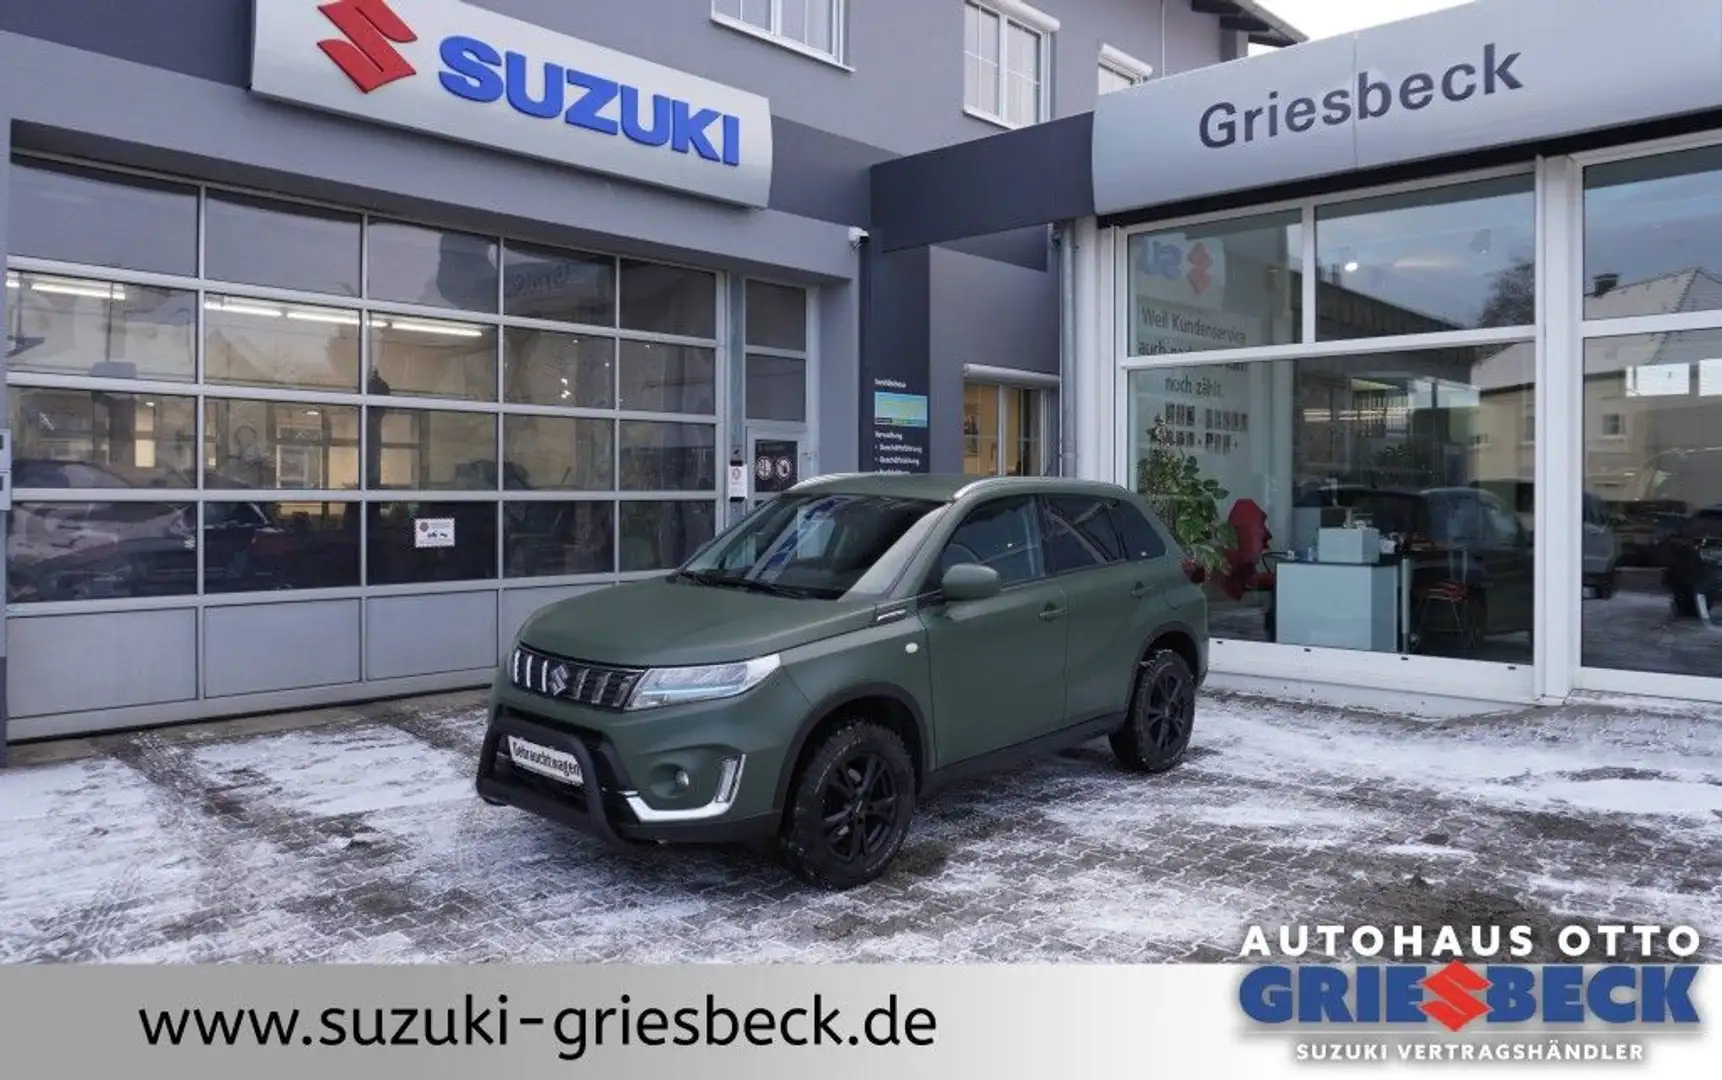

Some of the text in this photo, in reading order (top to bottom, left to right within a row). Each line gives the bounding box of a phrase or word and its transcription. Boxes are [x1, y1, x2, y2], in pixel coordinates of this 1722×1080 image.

[438, 35, 740, 167] SUZUKI
[1199, 42, 1524, 149] Griesbeck
[1141, 306, 1246, 344] Weil Kundenservice
[1165, 375, 1192, 395] noch
